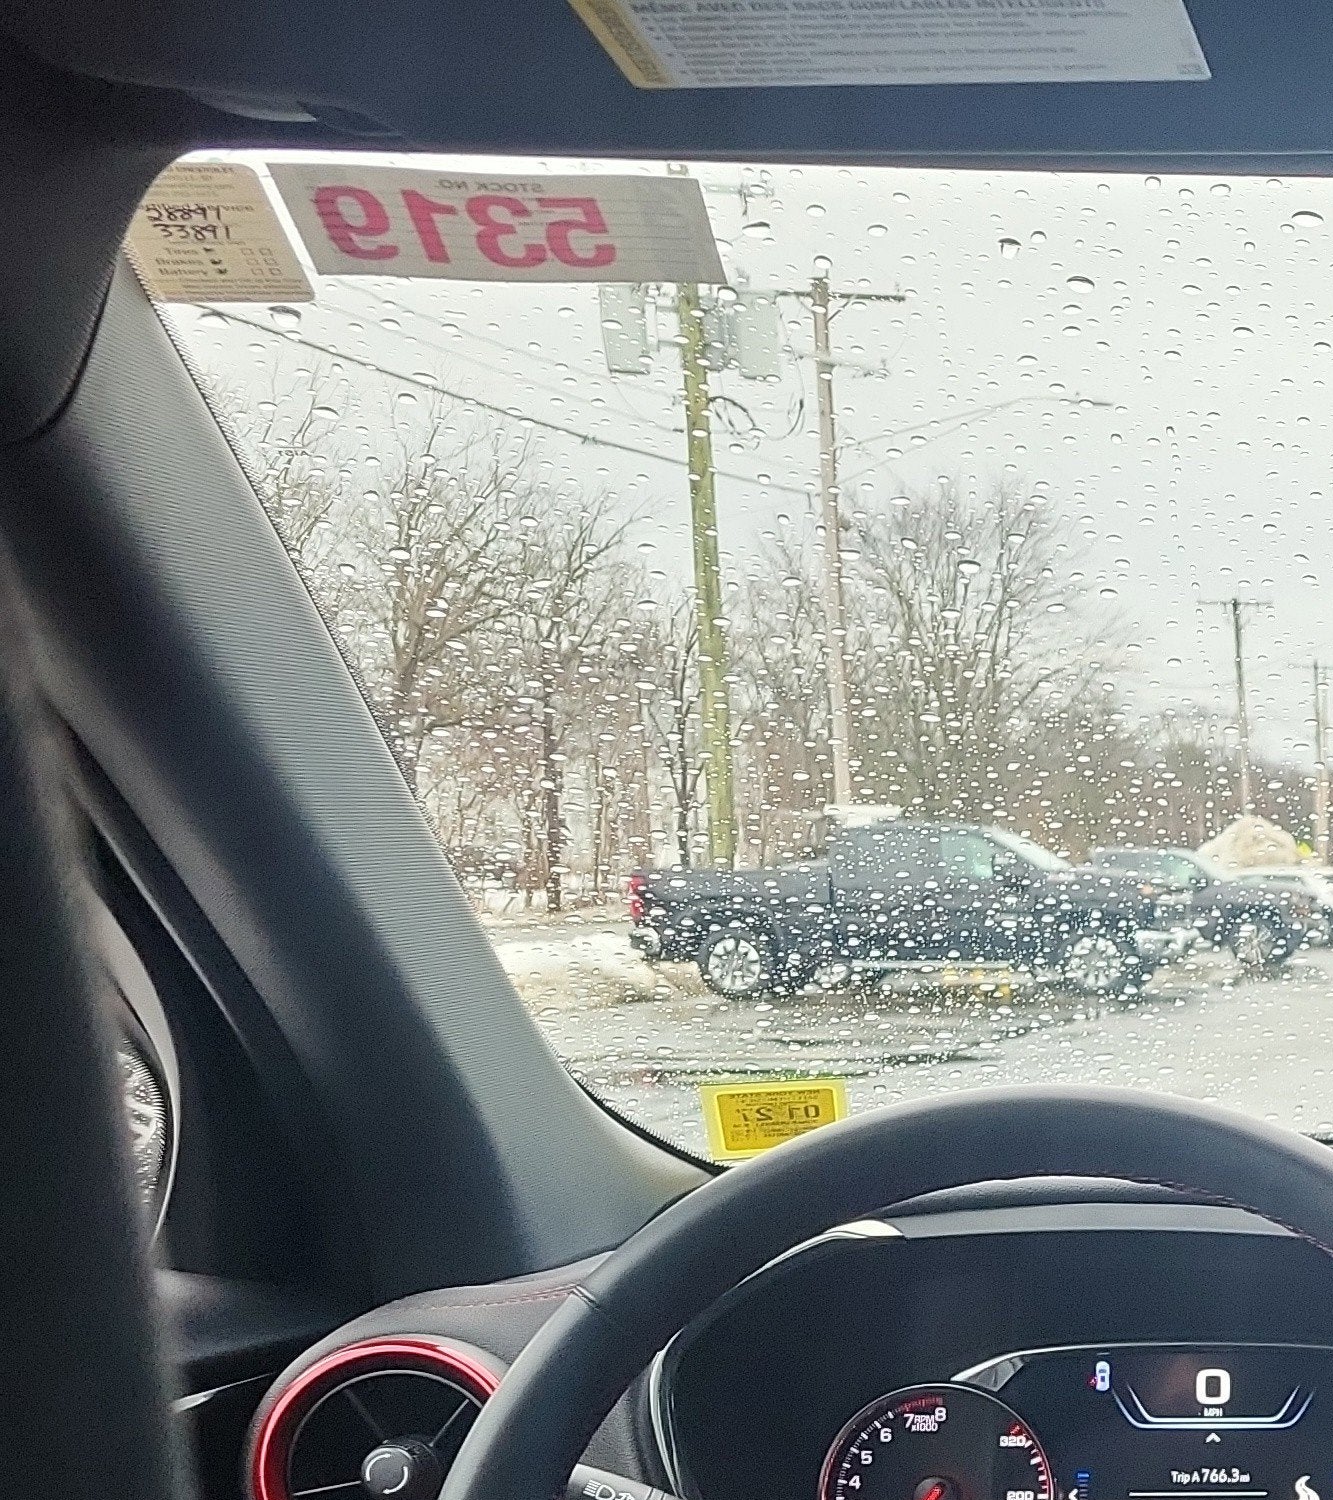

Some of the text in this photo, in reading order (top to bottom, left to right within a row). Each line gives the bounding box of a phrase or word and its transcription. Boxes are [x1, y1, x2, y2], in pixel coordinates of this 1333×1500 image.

[1195, 1368, 1231, 1405] 0
[934, 1407, 946, 1422] 8
[1203, 1407, 1223, 1417] MPH
[903, 1413, 914, 1428] 7
[880, 1427, 892, 1442] 6
[860, 1450, 873, 1465] 5
[849, 1475, 861, 1489] 4
[1171, 1471, 1190, 1485] Trip
[1191, 1471, 1200, 1483] A
[1201, 1468, 1240, 1483] 766.3
